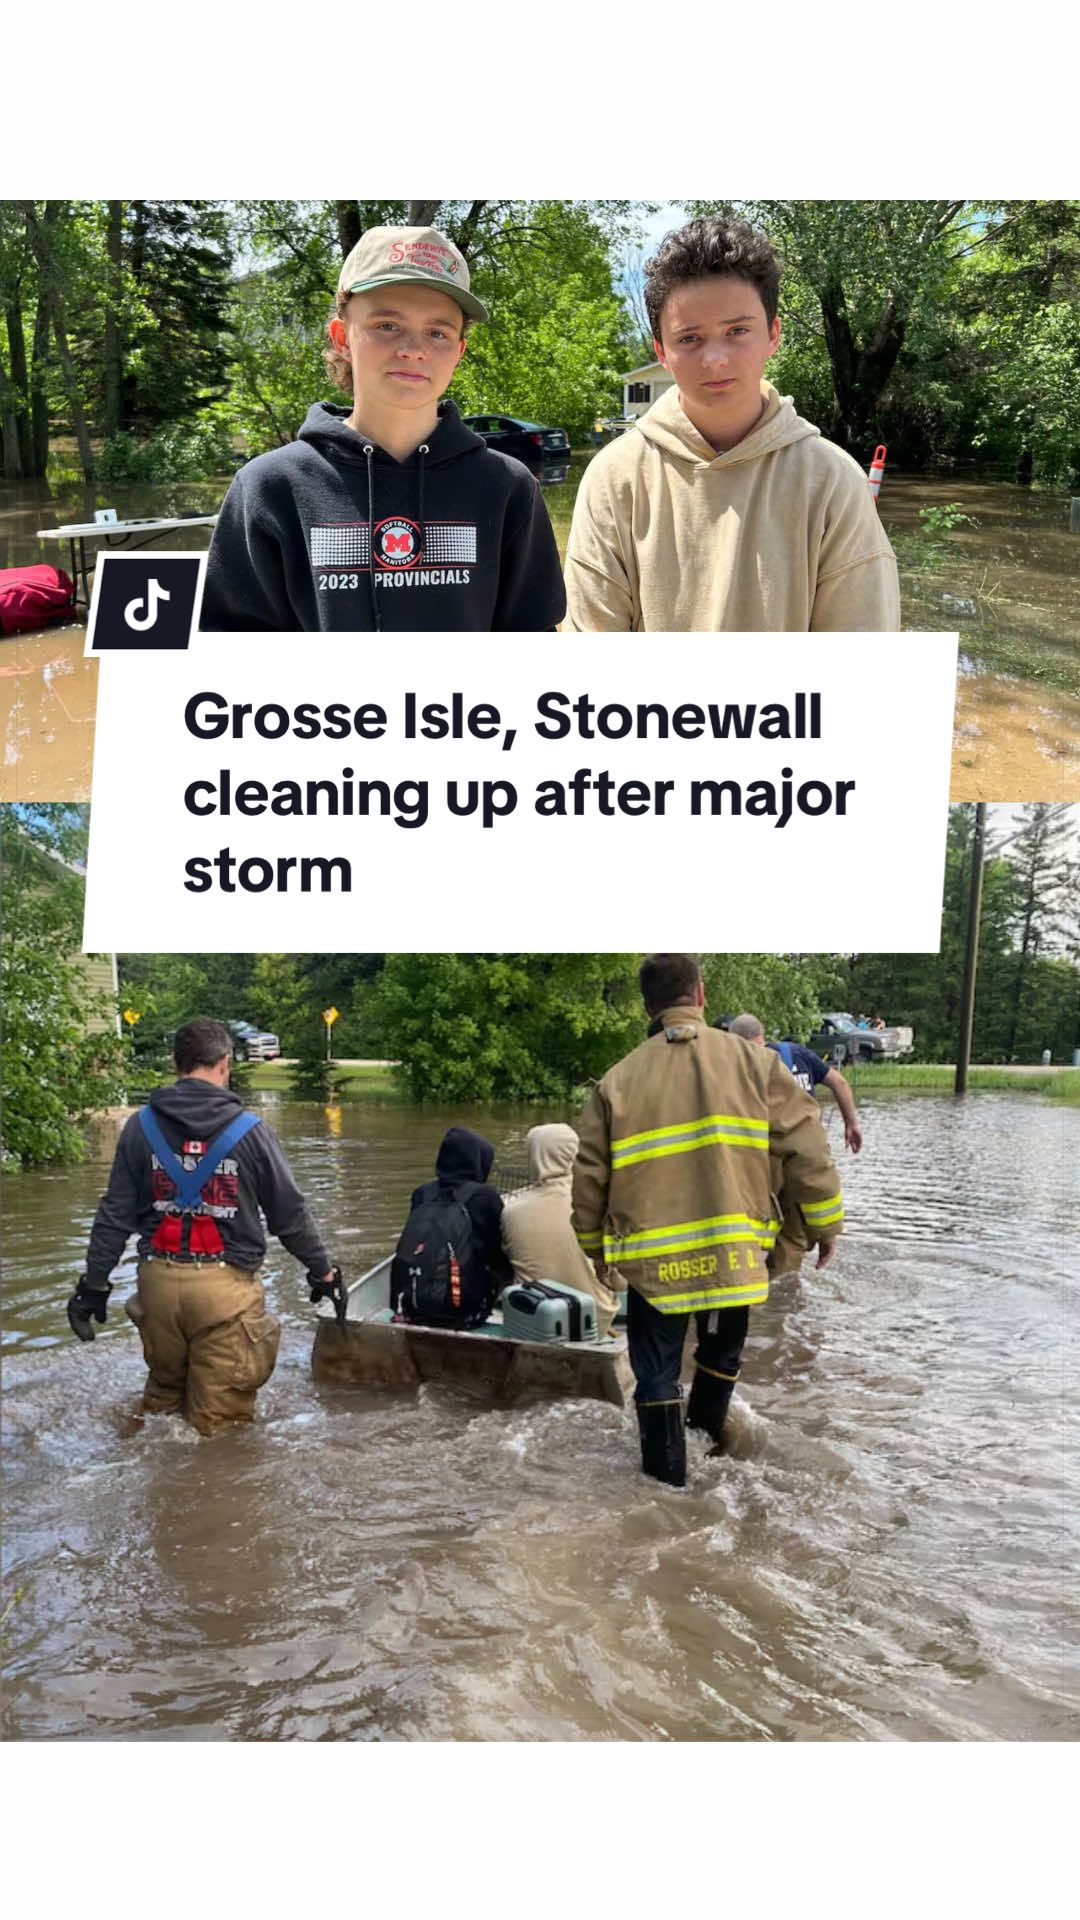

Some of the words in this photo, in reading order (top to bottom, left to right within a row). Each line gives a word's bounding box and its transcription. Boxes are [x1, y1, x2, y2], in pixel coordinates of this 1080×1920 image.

[380, 520, 414, 533] SOFTBALL
[384, 533, 411, 553] M
[380, 553, 416, 566] MANITOBA
[319, 574, 359, 591] 2023
[374, 569, 471, 588] PROVINCIALS
[658, 1254, 717, 1282] ROSSER
